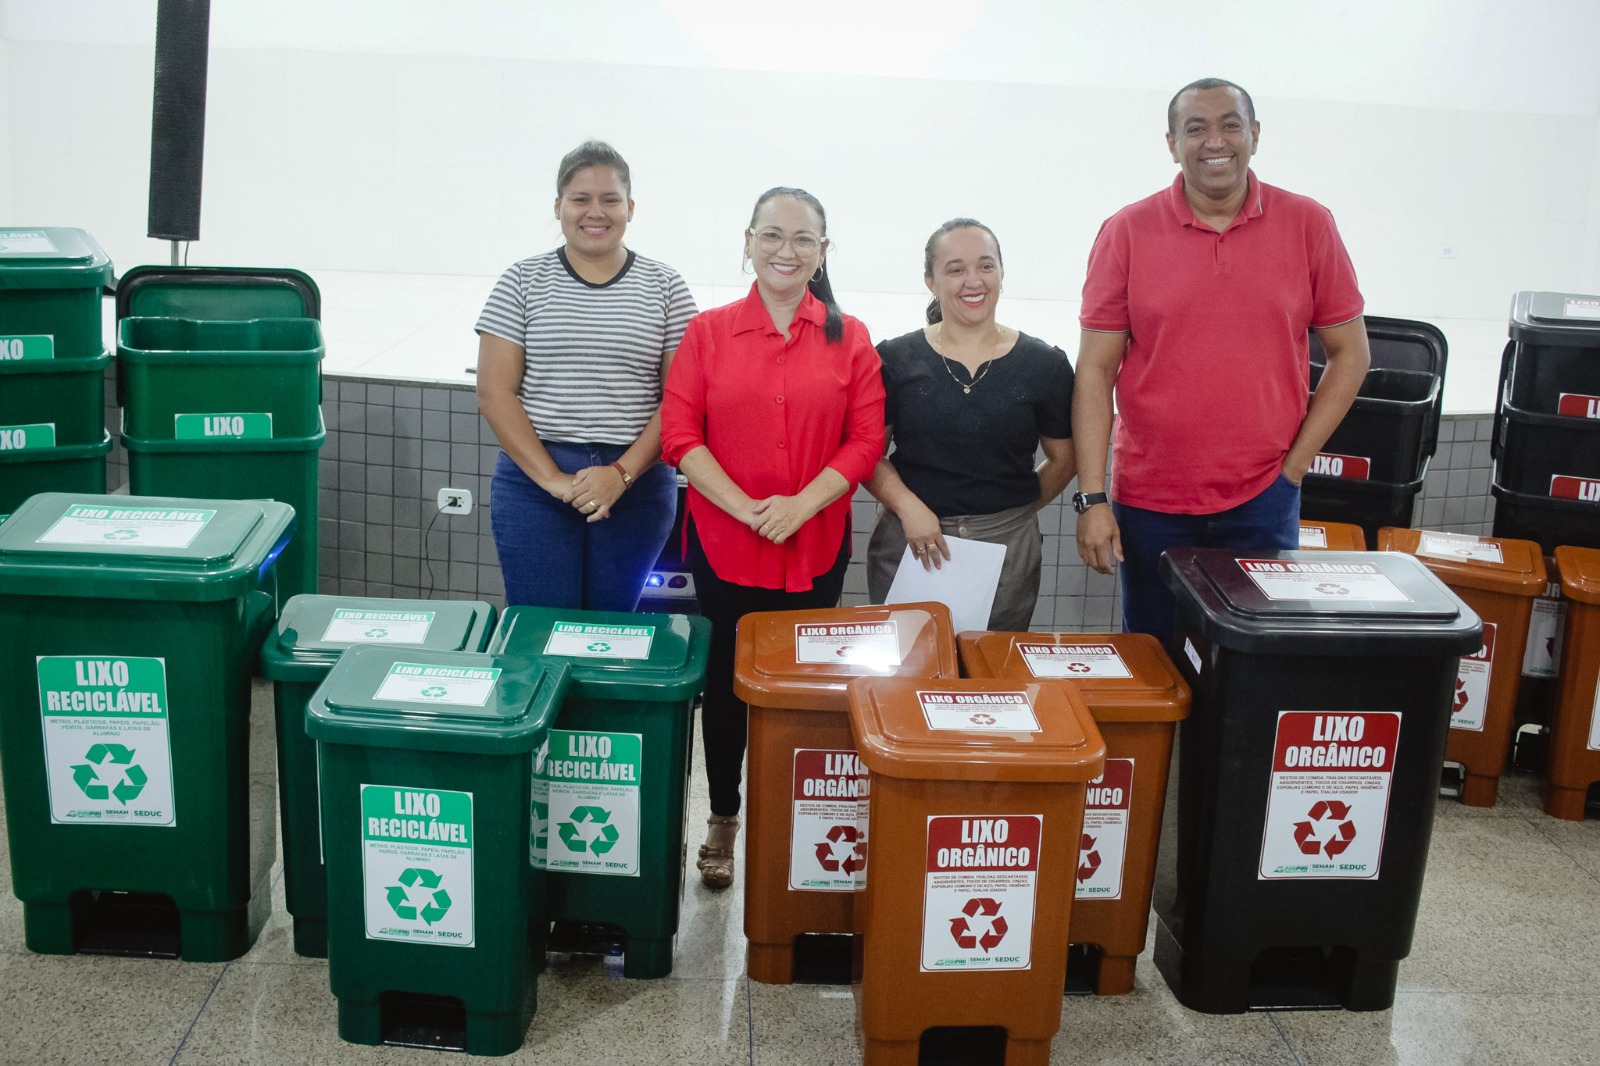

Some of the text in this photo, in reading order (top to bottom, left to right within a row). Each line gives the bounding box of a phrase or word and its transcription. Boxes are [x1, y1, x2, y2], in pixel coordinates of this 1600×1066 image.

[204, 416, 244, 436] LIXO
[71, 508, 205, 521] LIXO RECICLÁVEL
[1245, 562, 1377, 574] LIXO ORGÂNICO
[338, 611, 428, 622] LIXO RECICLÁVEL
[584, 626, 649, 636] RECICLÁVEL
[801, 624, 892, 635] LIXO ORGÂNICO
[1023, 646, 1113, 655] LIXO ORGÂNICO
[75, 661, 129, 687] LIXO
[395, 666, 493, 680] LIXO RECICLÁVEL
[47, 688, 162, 713] RECICLÁVEL
[924, 694, 1023, 704] LIXO ORGÂNICO
[1312, 715, 1365, 742] LIXO
[569, 735, 611, 758] LIXO
[1284, 742, 1387, 768] ORGÂNICO
[394, 791, 440, 817] LIXO
[368, 818, 467, 843] RECICLÁVEL
[961, 819, 1009, 844] LIXO
[937, 844, 1031, 868] ORGÂNICO
